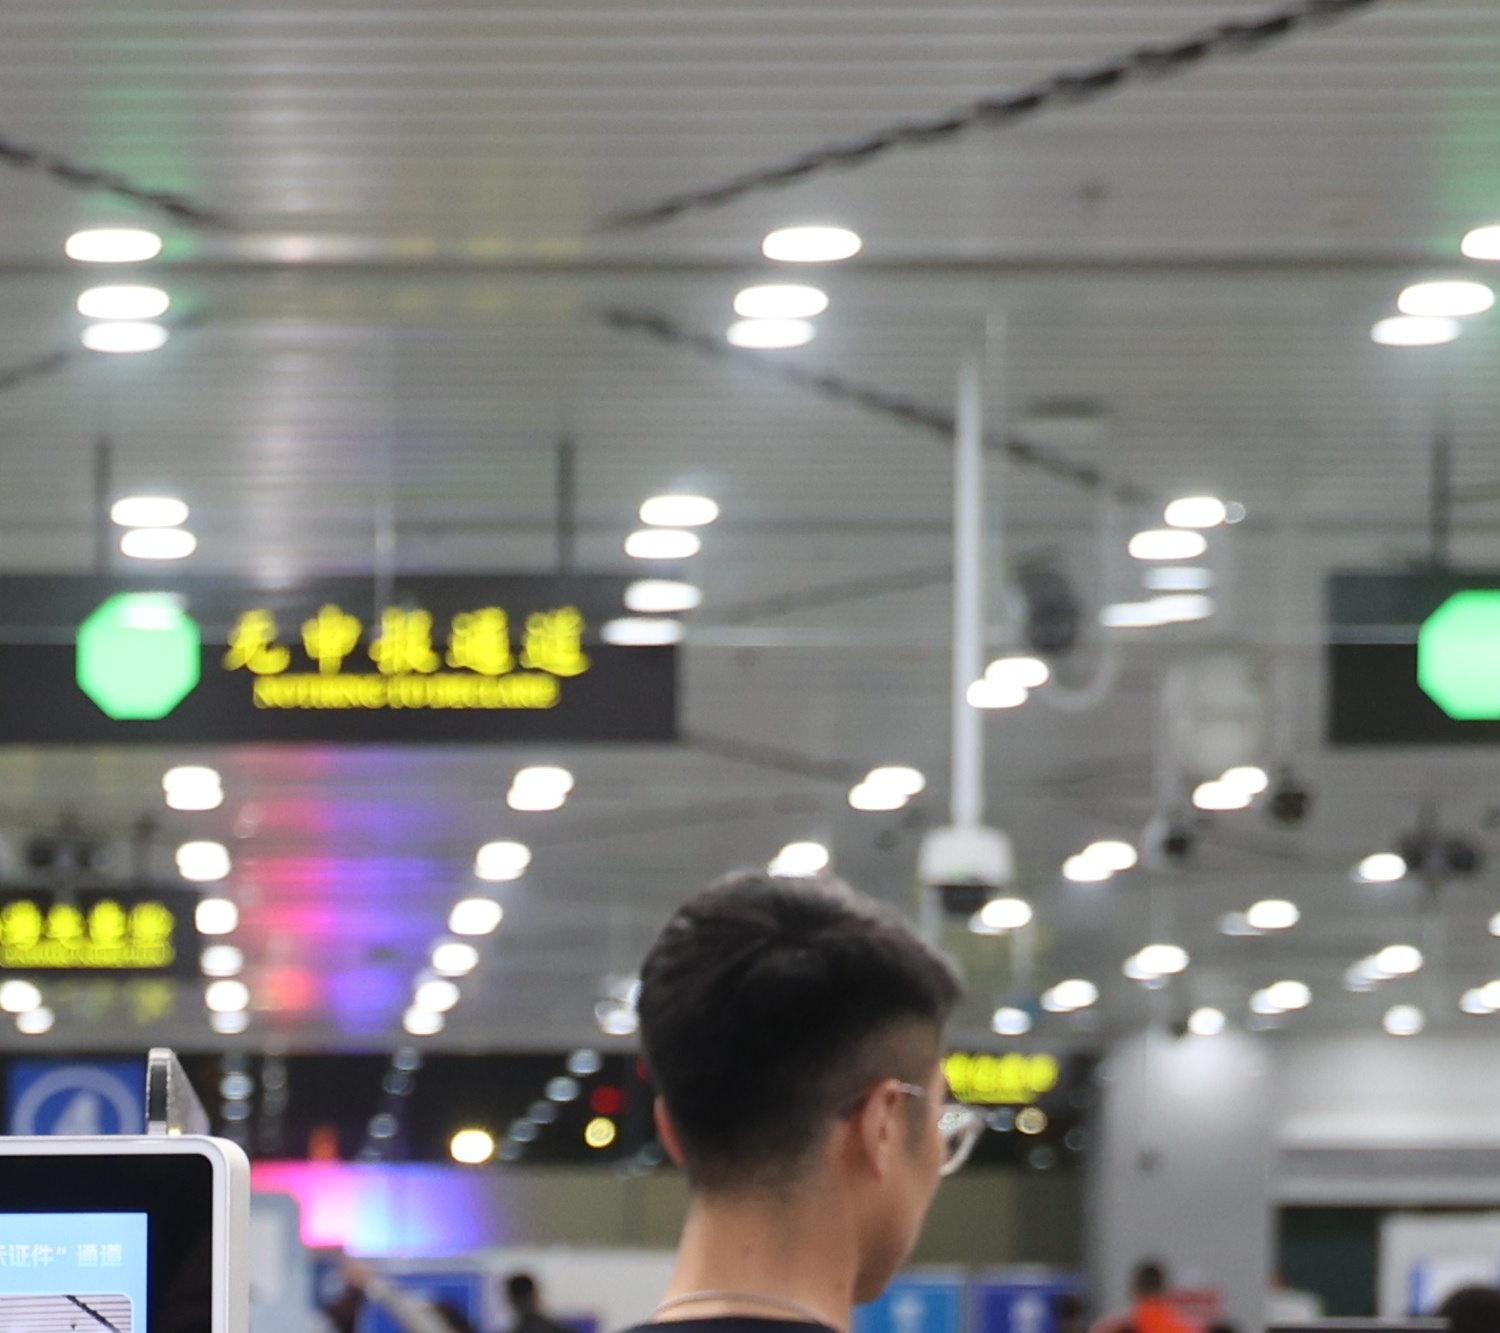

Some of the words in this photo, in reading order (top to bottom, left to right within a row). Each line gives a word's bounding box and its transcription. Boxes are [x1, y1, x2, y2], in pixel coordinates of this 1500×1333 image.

[222, 604, 591, 676] 无申报通道
